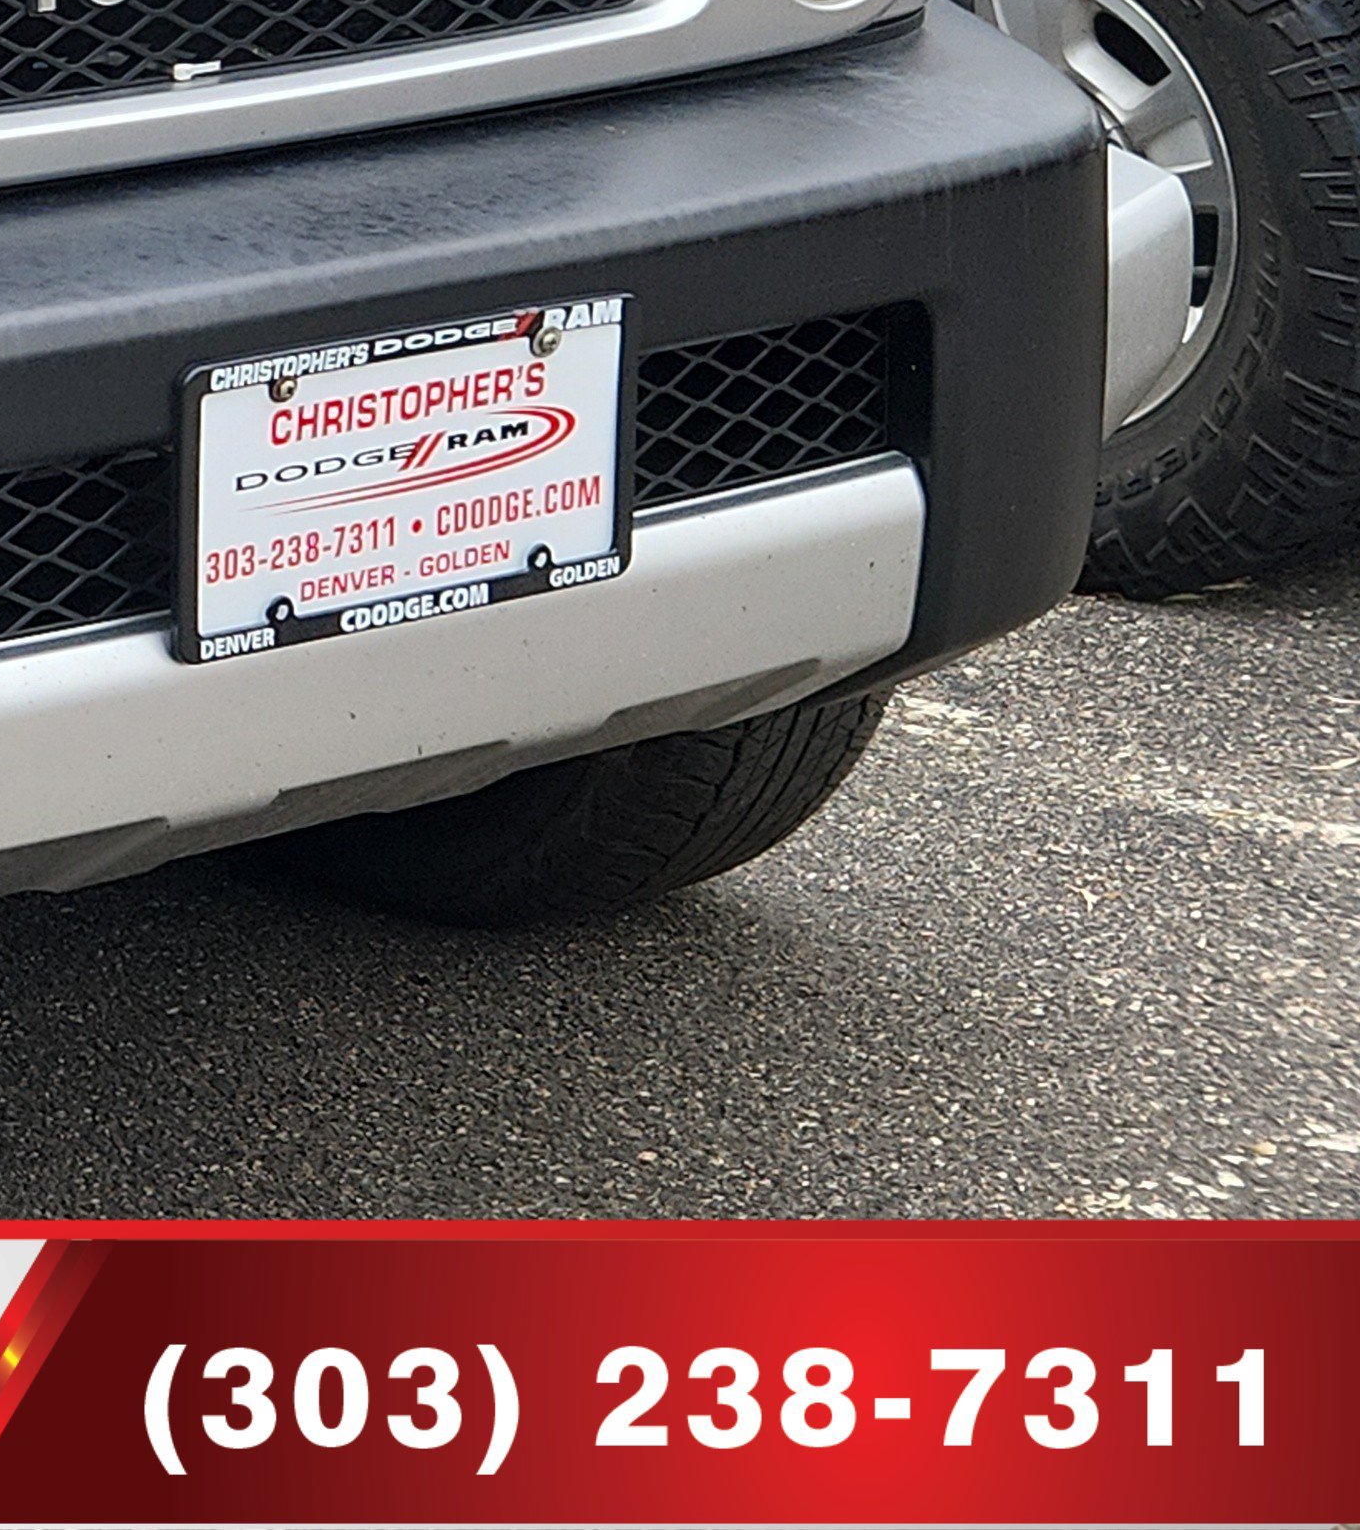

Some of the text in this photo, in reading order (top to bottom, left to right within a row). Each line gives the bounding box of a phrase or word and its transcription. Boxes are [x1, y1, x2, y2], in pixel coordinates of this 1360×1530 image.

[210, 298, 623, 391] CHRISTOPHER'S DODGE RAM
[271, 362, 546, 446] CHRISTOPHER'S
[235, 421, 530, 491] DODGE RAM
[206, 475, 601, 584] 303-238-7311 CDODGE.COM
[300, 564, 395, 602] DENVER
[420, 540, 510, 577] GOLDEN
[200, 556, 620, 660] DENVER CDODGE.COM GOLDEN
